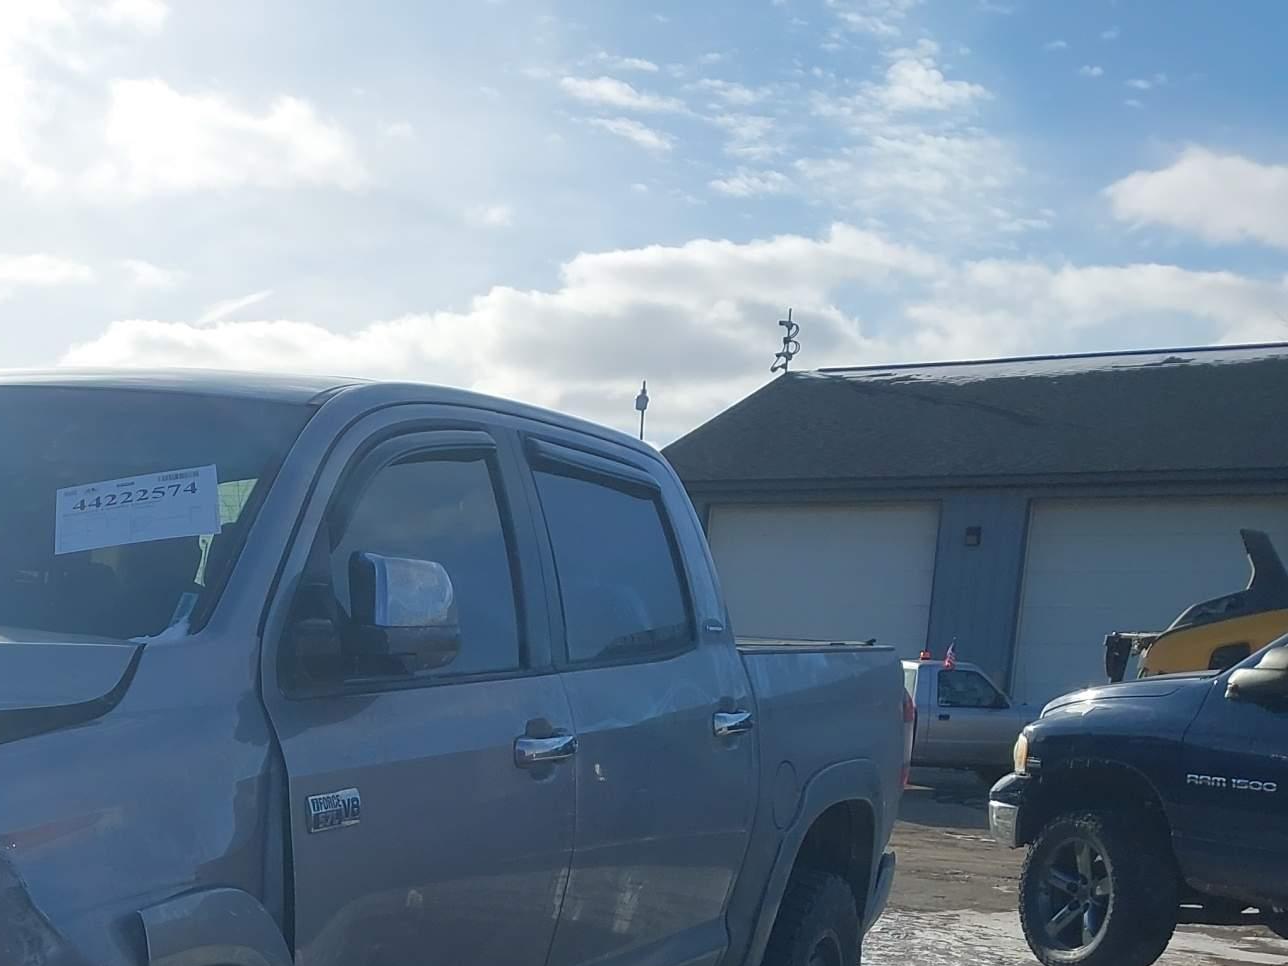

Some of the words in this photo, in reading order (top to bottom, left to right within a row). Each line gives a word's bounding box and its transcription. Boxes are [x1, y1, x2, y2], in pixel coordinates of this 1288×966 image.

[72, 481, 198, 511] 44222574
[1186, 773, 1227, 787] RAM
[1231, 778, 1277, 792] 1500
[341, 796, 361, 818] V8
